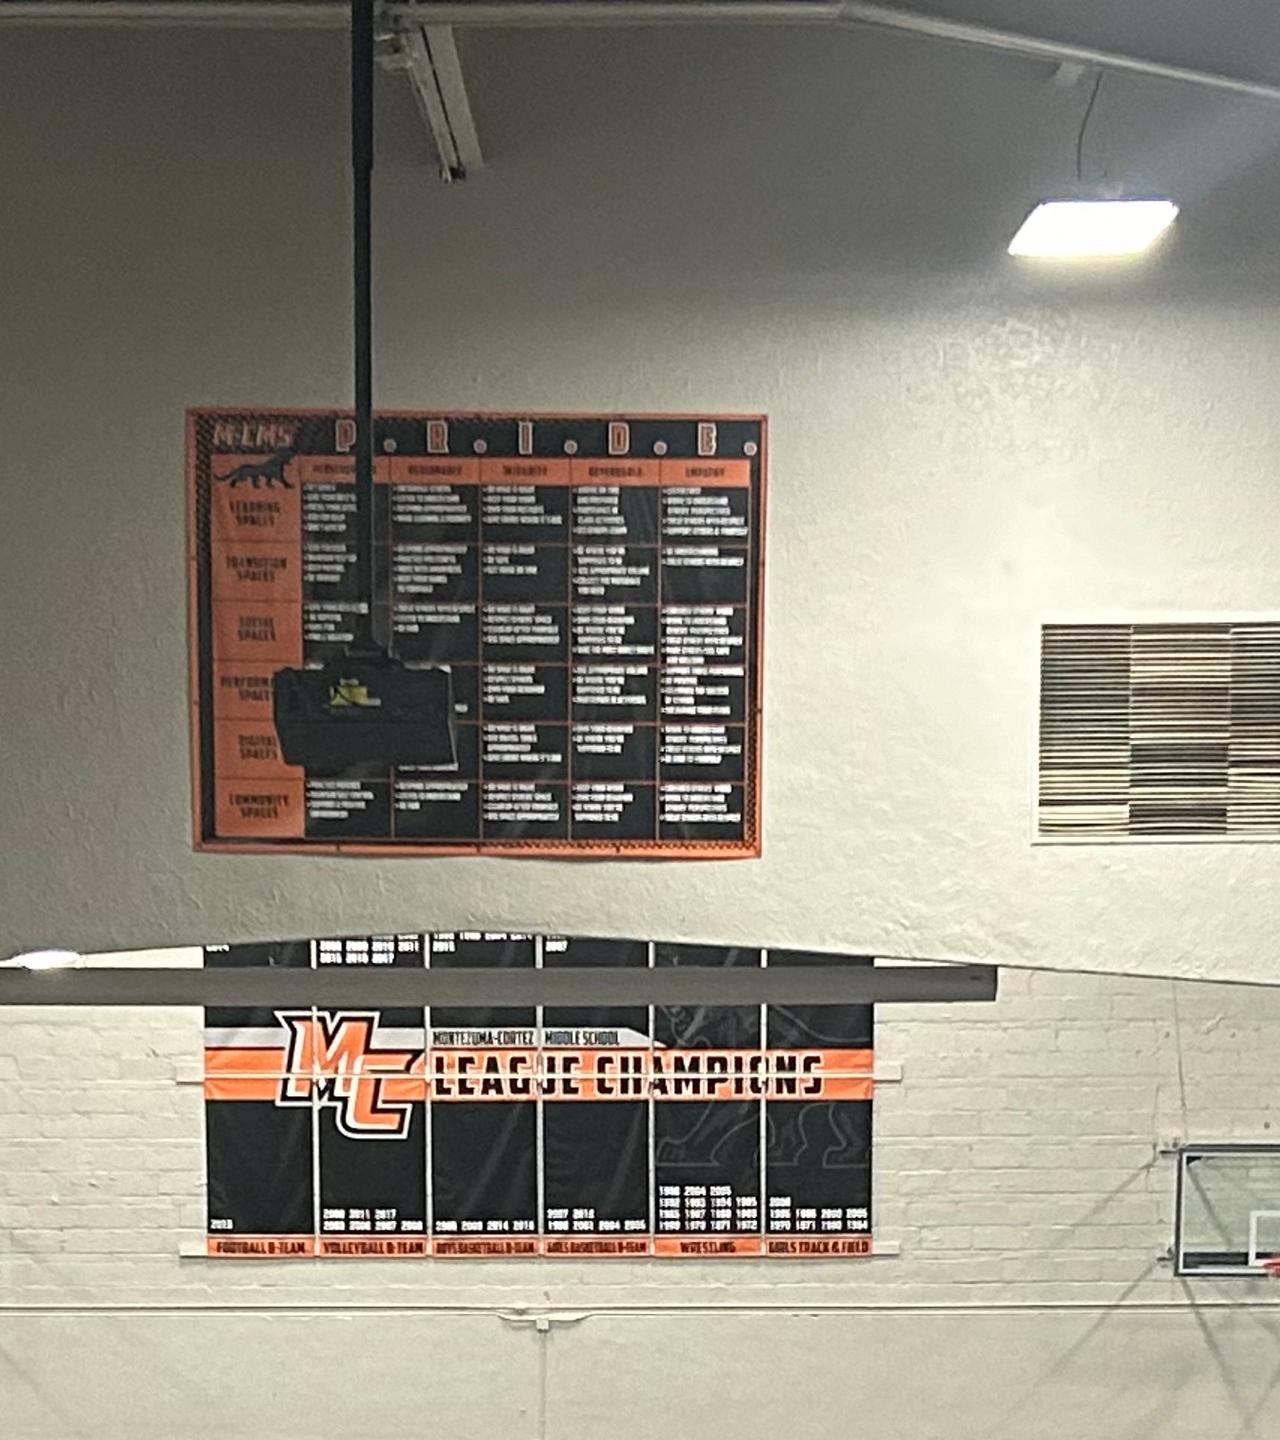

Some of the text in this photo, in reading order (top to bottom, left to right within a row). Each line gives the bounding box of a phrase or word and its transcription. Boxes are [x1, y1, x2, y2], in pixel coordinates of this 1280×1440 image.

[608, 422, 630, 455] D
[697, 422, 718, 456] E
[432, 1030, 620, 1045] MONTEZUMA-CORTEZ MIDDLE SCHOOL
[434, 1055, 823, 1095] LEAGUE CHAMPIONS
[323, 1242, 385, 1254] VOLLEYBALL
[680, 1242, 736, 1254] WRESTLING
[769, 1241, 797, 1253] GIRLS
[799, 1241, 830, 1253] TRACK
[842, 1241, 870, 1253] FIELD
